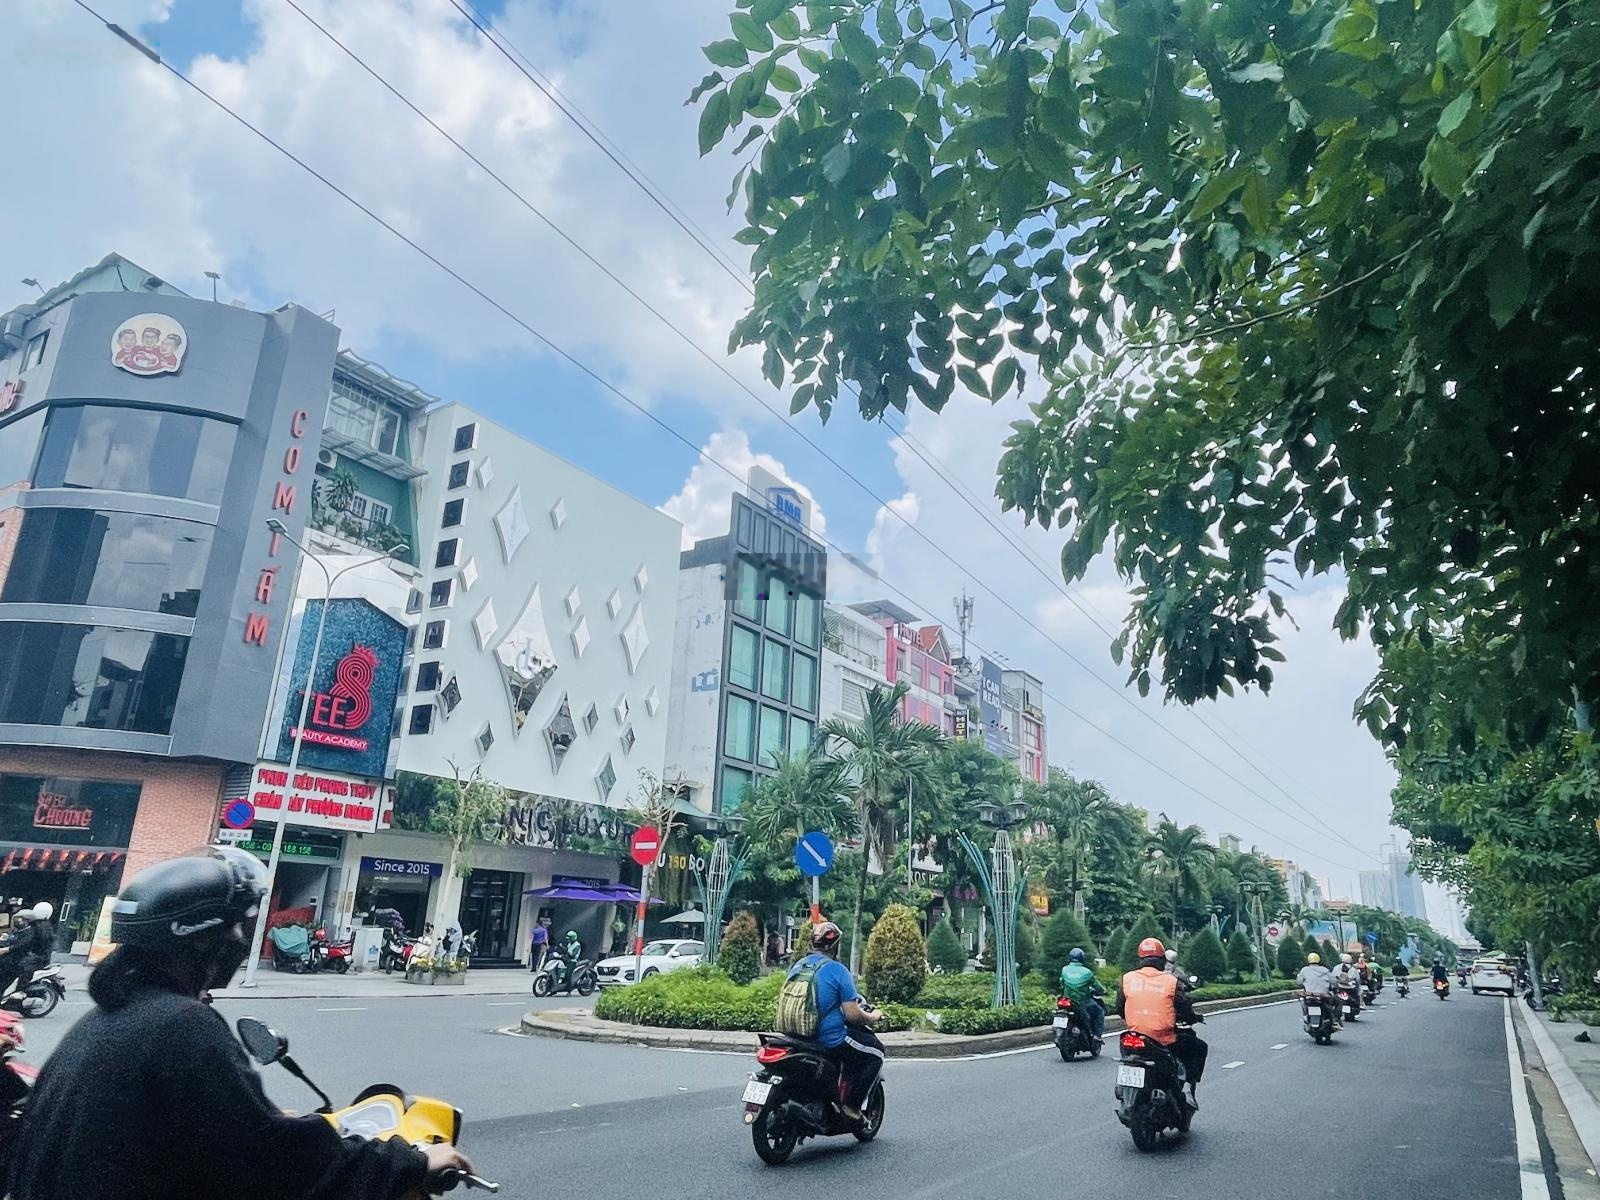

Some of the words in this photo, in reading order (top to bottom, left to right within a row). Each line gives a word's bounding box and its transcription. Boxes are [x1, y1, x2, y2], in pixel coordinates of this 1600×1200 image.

[290, 726, 322, 742] BAUTY
[325, 734, 368, 751] ACADEMY
[374, 859, 405, 873] Since
[406, 862, 430, 875] 2015
